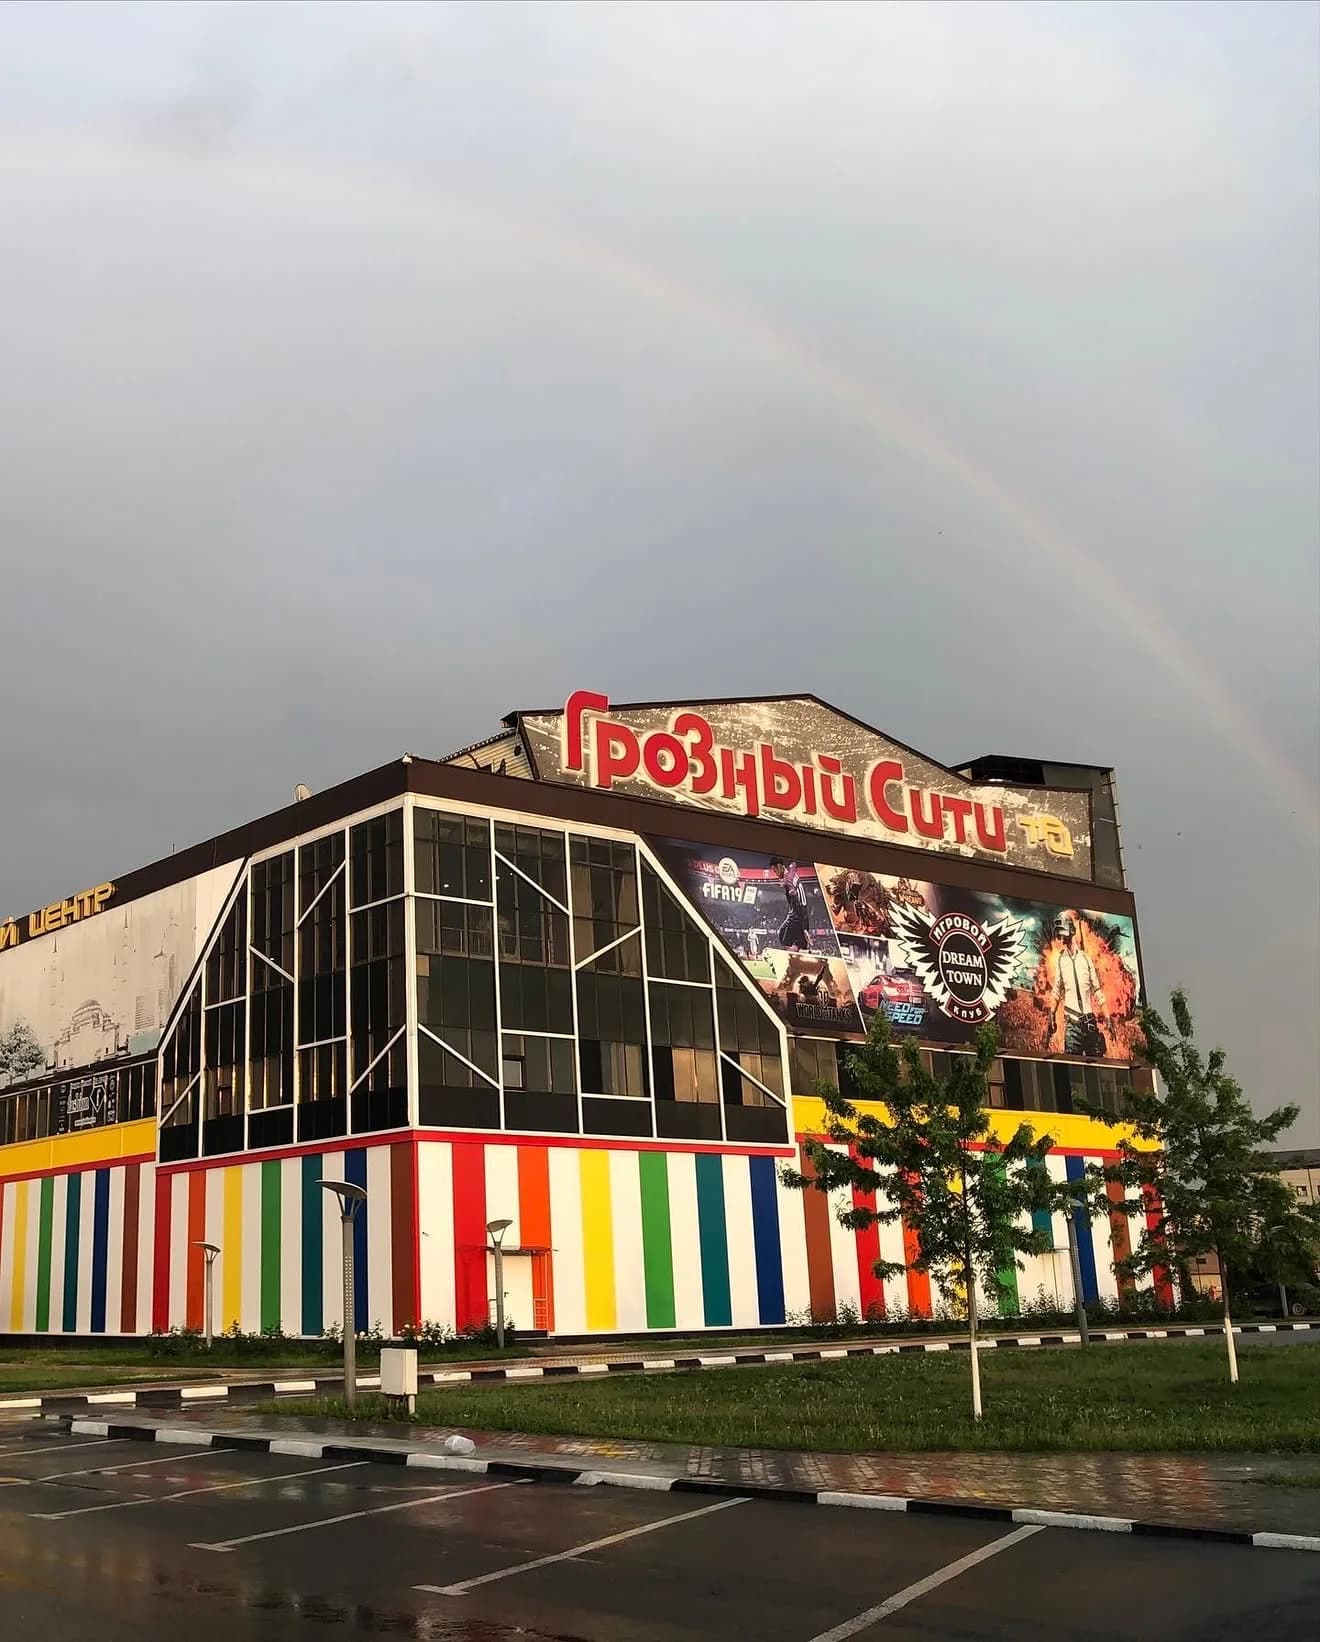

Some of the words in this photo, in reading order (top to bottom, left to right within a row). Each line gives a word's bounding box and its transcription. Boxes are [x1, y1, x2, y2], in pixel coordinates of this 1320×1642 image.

[870, 760, 1007, 853] Сити
[722, 862, 735, 873] EA
[29, 882, 116, 937] ЦЕНТР
[941, 951, 984, 969] DREAM
[946, 969, 983, 986] TOWN
[880, 1000, 911, 1013] NEED
[885, 1012, 922, 1025] SPEED
